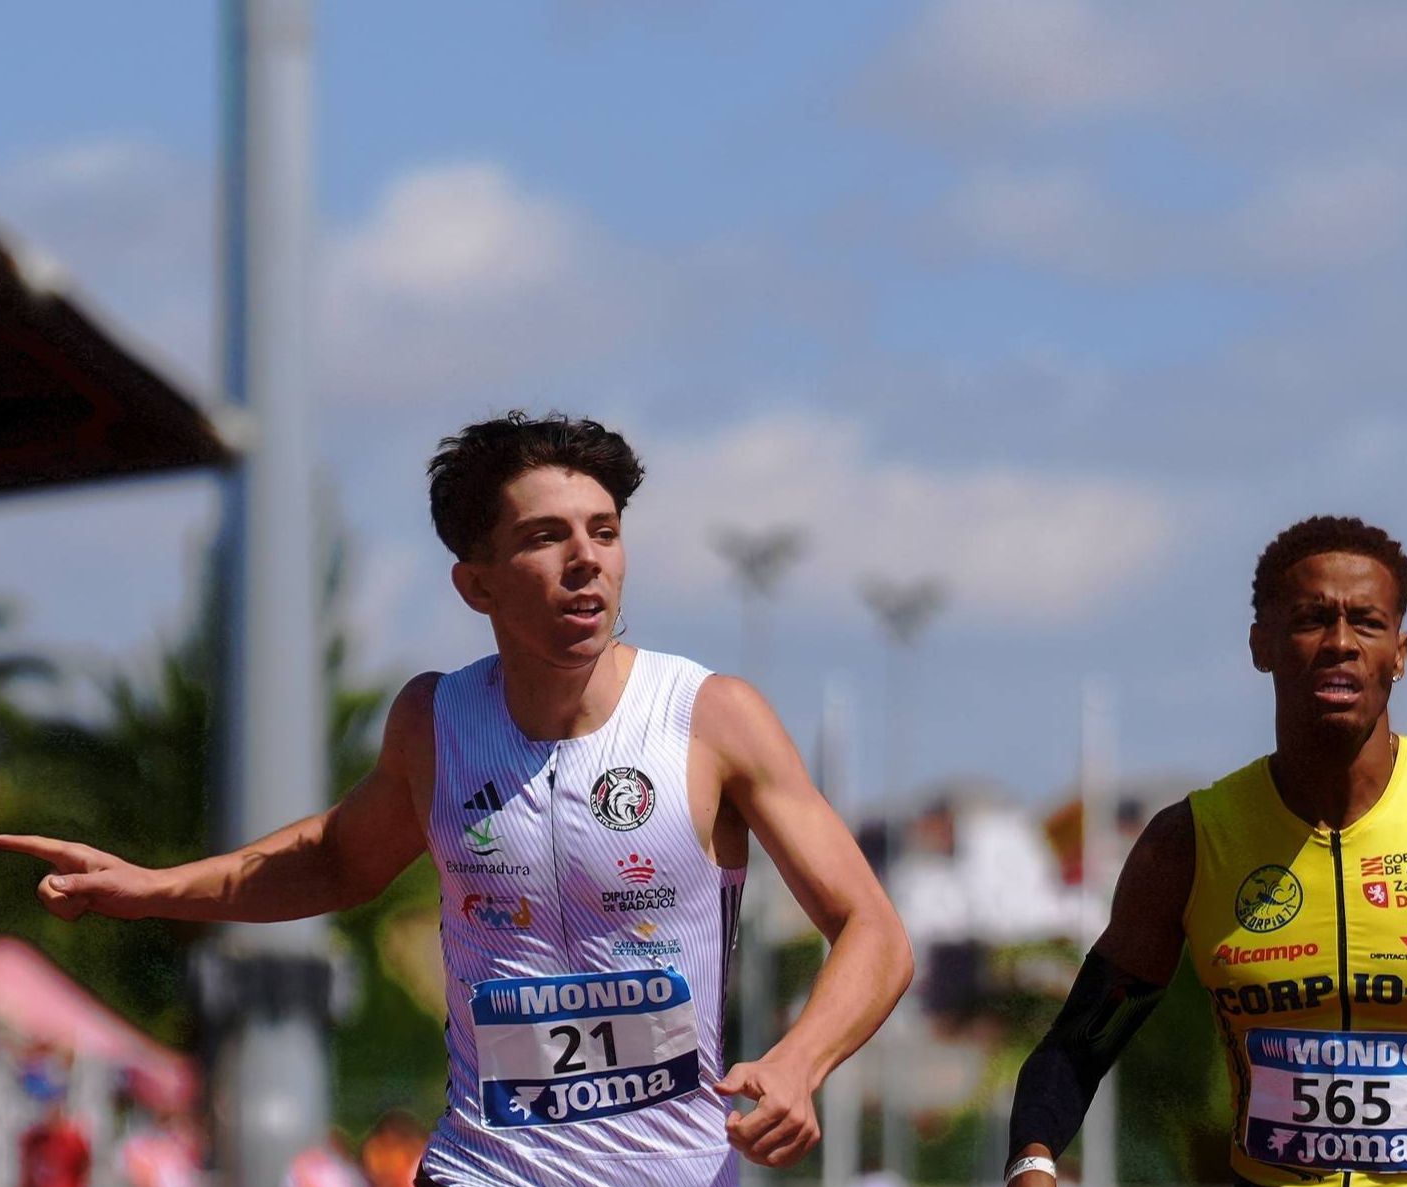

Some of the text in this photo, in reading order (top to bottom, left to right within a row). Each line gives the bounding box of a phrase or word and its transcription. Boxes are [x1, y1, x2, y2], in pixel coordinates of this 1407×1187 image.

[446, 861, 531, 876] Extremadura
[1384, 865, 1402, 876] DE
[602, 886, 676, 903] DIPUTACIÓN
[603, 897, 676, 913] DE BADAJOZ
[612, 946, 682, 957] EXTREMADURA
[638, 939, 666, 949] RURAL
[668, 938, 679, 947] DE
[1212, 943, 1319, 966] Alcampo
[519, 976, 673, 1015] MONDO
[549, 1021, 618, 1074] 21
[1292, 1077, 1392, 1126] 565
